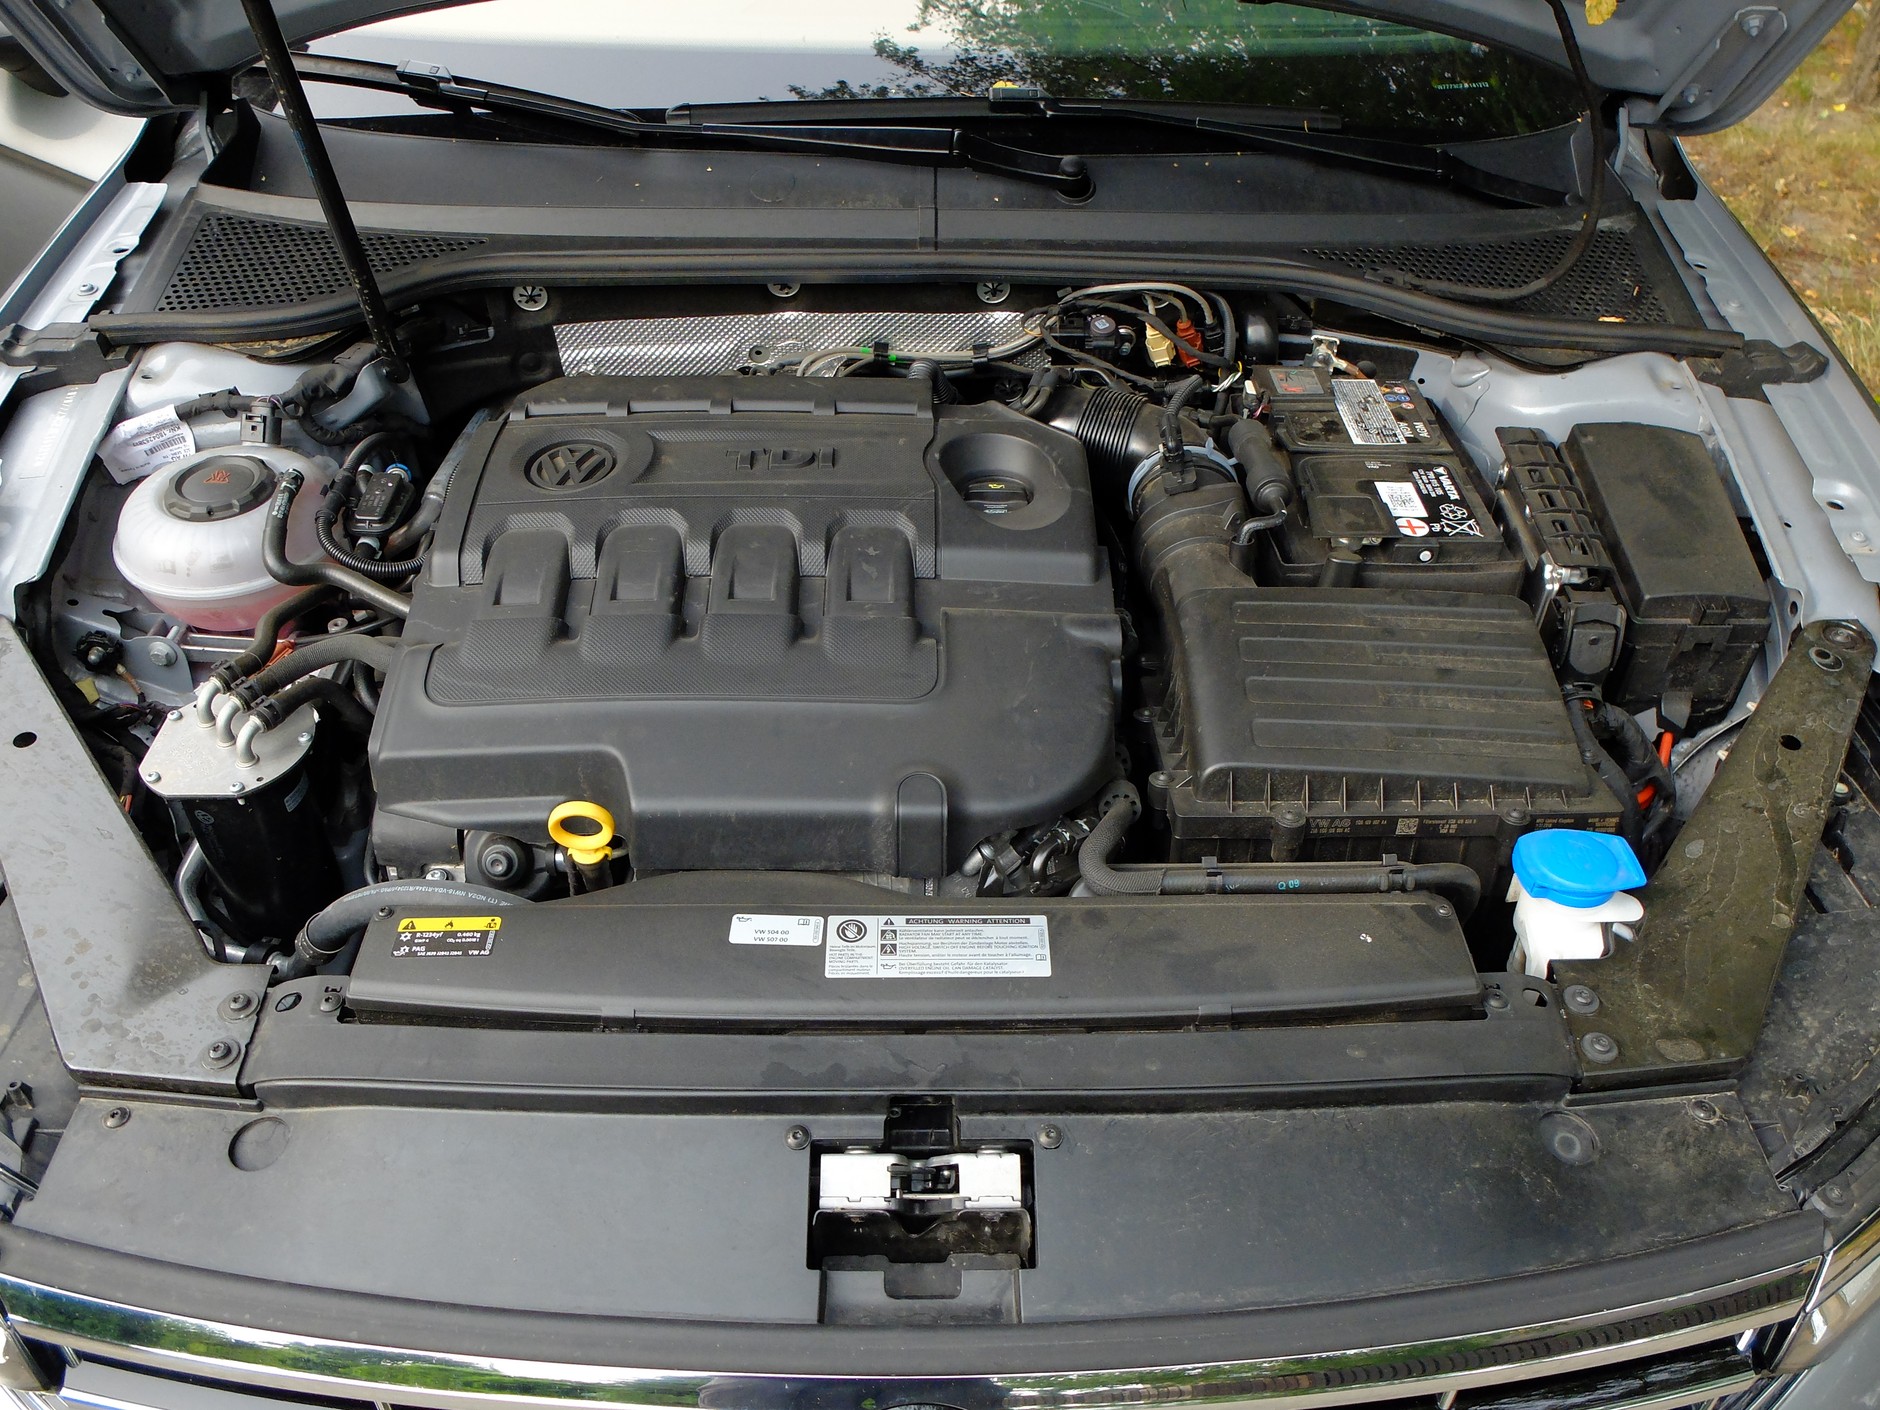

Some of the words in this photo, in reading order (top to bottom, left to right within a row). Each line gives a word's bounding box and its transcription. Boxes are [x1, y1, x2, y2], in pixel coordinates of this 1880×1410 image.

[1397, 421, 1414, 438] AGM
[1413, 422, 1431, 438] AGM
[725, 447, 836, 471] TDI
[1439, 475, 1460, 500] VARTA
[1428, 522, 1442, 532] Pb
[1309, 818, 1331, 828] VW
[1331, 818, 1352, 828] AG
